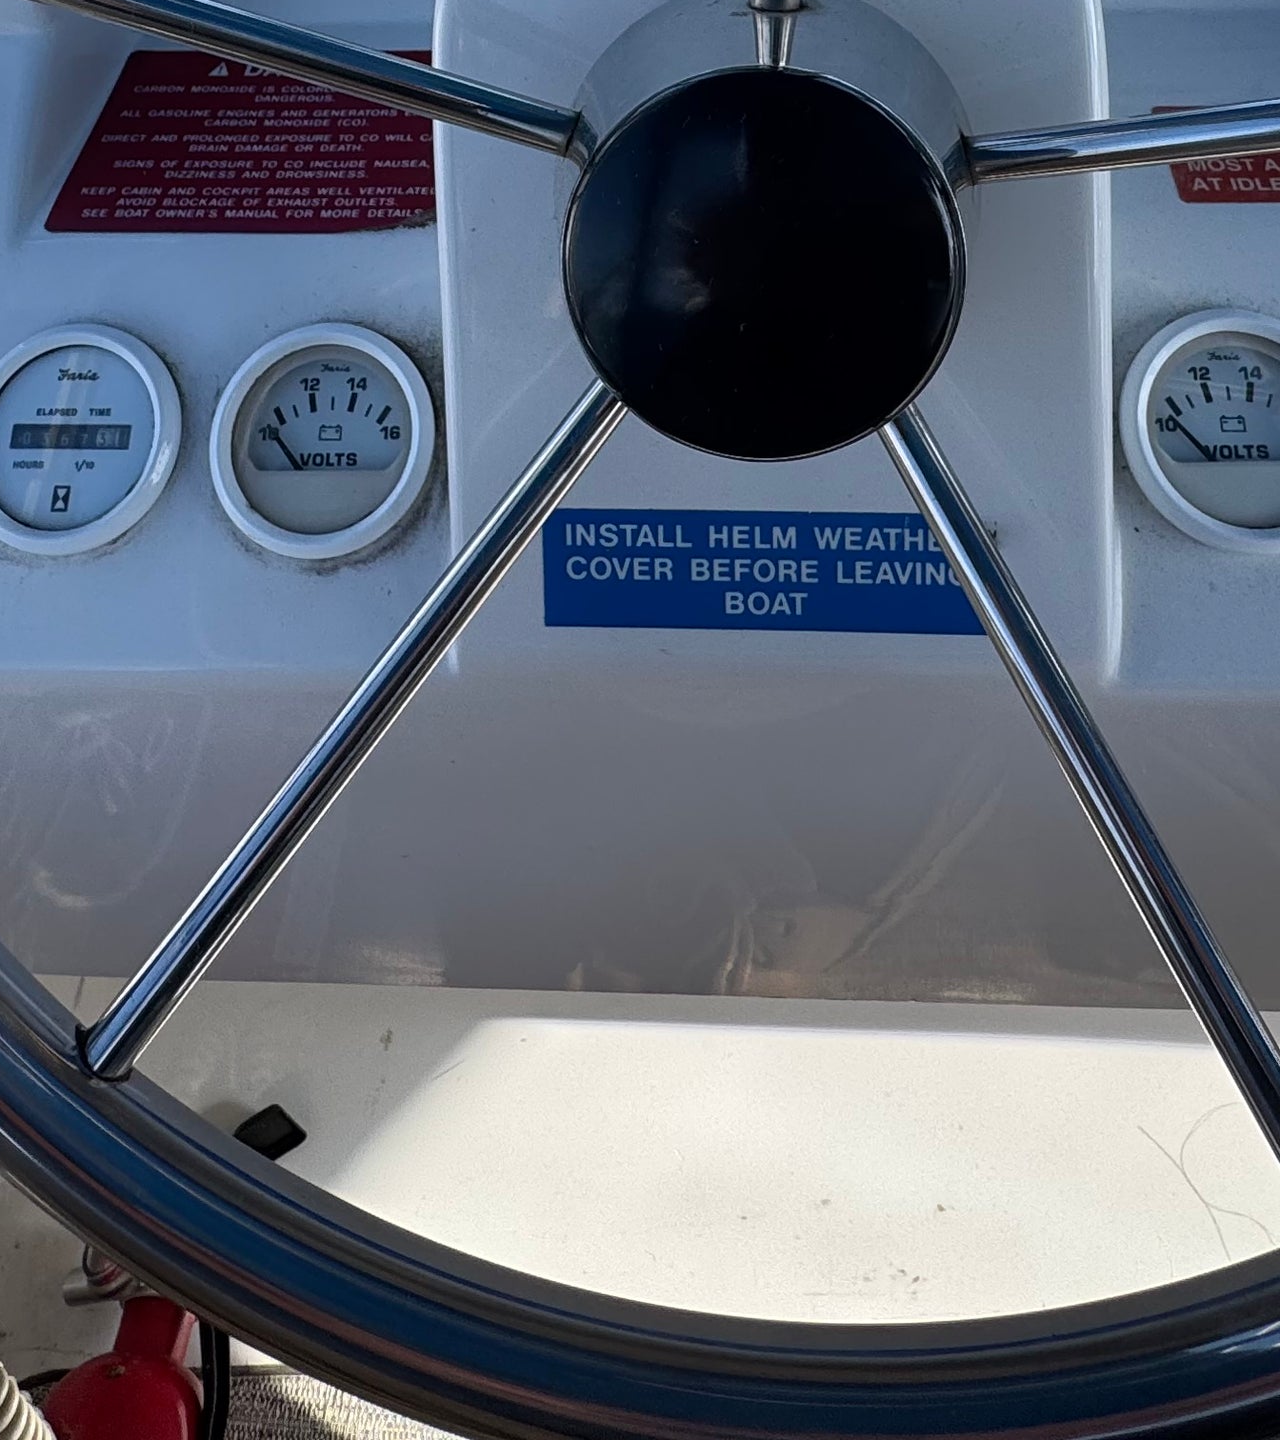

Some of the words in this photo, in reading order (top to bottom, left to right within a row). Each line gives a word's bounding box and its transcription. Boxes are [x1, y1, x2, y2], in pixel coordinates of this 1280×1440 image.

[133, 85, 185, 93] CARBON
[190, 85, 257, 93] MONOXIDE
[262, 85, 275, 93] IS
[120, 109, 142, 118] ALL
[148, 109, 212, 118] GASOLINE
[217, 109, 275, 118] ENGINES
[280, 109, 307, 118] AND
[312, 109, 398, 118] GENERATORS
[204, 118, 257, 127] CARBON
[263, 118, 331, 127] MONOXIDE
[101, 134, 147, 143] DIRECT
[151, 134, 178, 143] AND
[183, 134, 260, 143] PROLONGED
[265, 134, 332, 143] EXPOSURE
[339, 134, 355, 143] TO
[360, 134, 380, 143] CO
[385, 134, 414, 143] WILL
[188, 144, 229, 152] BRAIN
[234, 144, 289, 152] DAMAGE
[294, 144, 314, 152] OR
[113, 160, 155, 169] SIGNS
[160, 160, 179, 169] OF
[184, 160, 254, 169] EXPOSURE
[262, 160, 278, 169] TO
[283, 160, 304, 169] CO
[310, 160, 367, 169] INCLUDE
[1187, 159, 1255, 172] MOST
[164, 170, 236, 179] DIZZINESS
[241, 170, 270, 179] AND
[1192, 177, 1225, 191] AT
[80, 186, 116, 196] KEEP
[121, 186, 162, 196] CABIN
[167, 186, 196, 196] AND
[202, 186, 261, 196] COCKPIT
[266, 186, 310, 196] AREAS
[317, 186, 352, 196] WELL
[116, 197, 157, 207] AVOID
[162, 197, 236, 207] BLOCKAGE
[242, 197, 261, 207] OF
[267, 197, 328, 207] EXHAUST
[81, 208, 108, 218] SEE
[114, 208, 149, 218] BOAT
[155, 208, 218, 218] OWNER'S
[224, 208, 279, 218] MANUAL
[285, 208, 314, 218] FOR
[320, 208, 360, 218] MORE
[1188, 366, 1211, 381] 12
[1238, 365, 1262, 381] 14
[299, 377, 320, 393] 12
[346, 376, 368, 392] 14
[36, 407, 78, 417] ELAPSED
[89, 407, 112, 417] TIME
[1155, 416, 1178, 433] 10
[379, 425, 402, 441] 16
[1202, 444, 1270, 461] VOLTS
[12, 460, 45, 470] HOURS
[298, 452, 358, 468] VOLTS
[565, 523, 692, 549] INSTALL
[708, 525, 798, 550] HELM
[565, 556, 674, 582] COVER
[690, 559, 819, 585] BEFORE
[725, 592, 809, 617] BOAT
